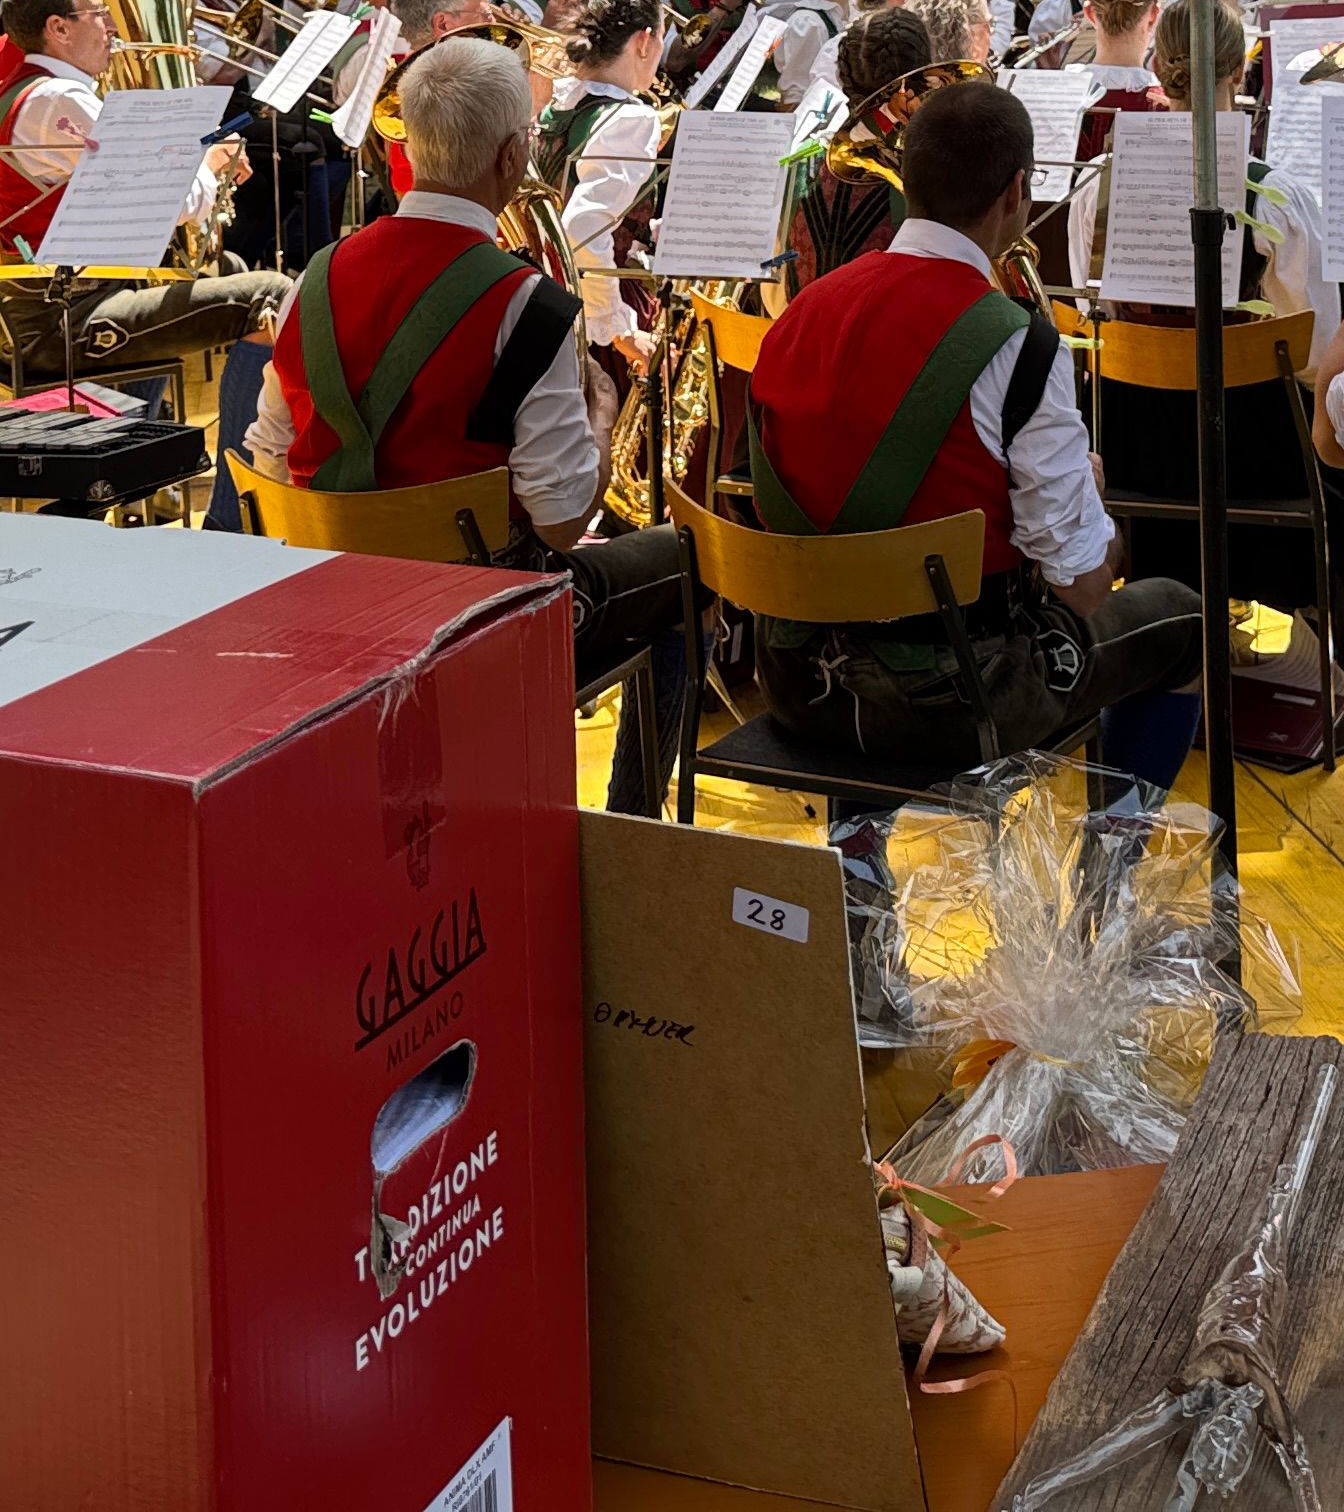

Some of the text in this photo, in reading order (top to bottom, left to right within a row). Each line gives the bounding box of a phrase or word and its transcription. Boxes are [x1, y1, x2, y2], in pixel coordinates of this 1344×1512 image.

[354, 888, 487, 1053] GAGGIA
[746, 899, 786, 931] 28
[385, 990, 465, 1073] MILANO
[354, 1130, 498, 1282] TDIZIONE
[406, 1193, 481, 1277] CONTINUA
[356, 1206, 504, 1372] EVOLUZIONE
